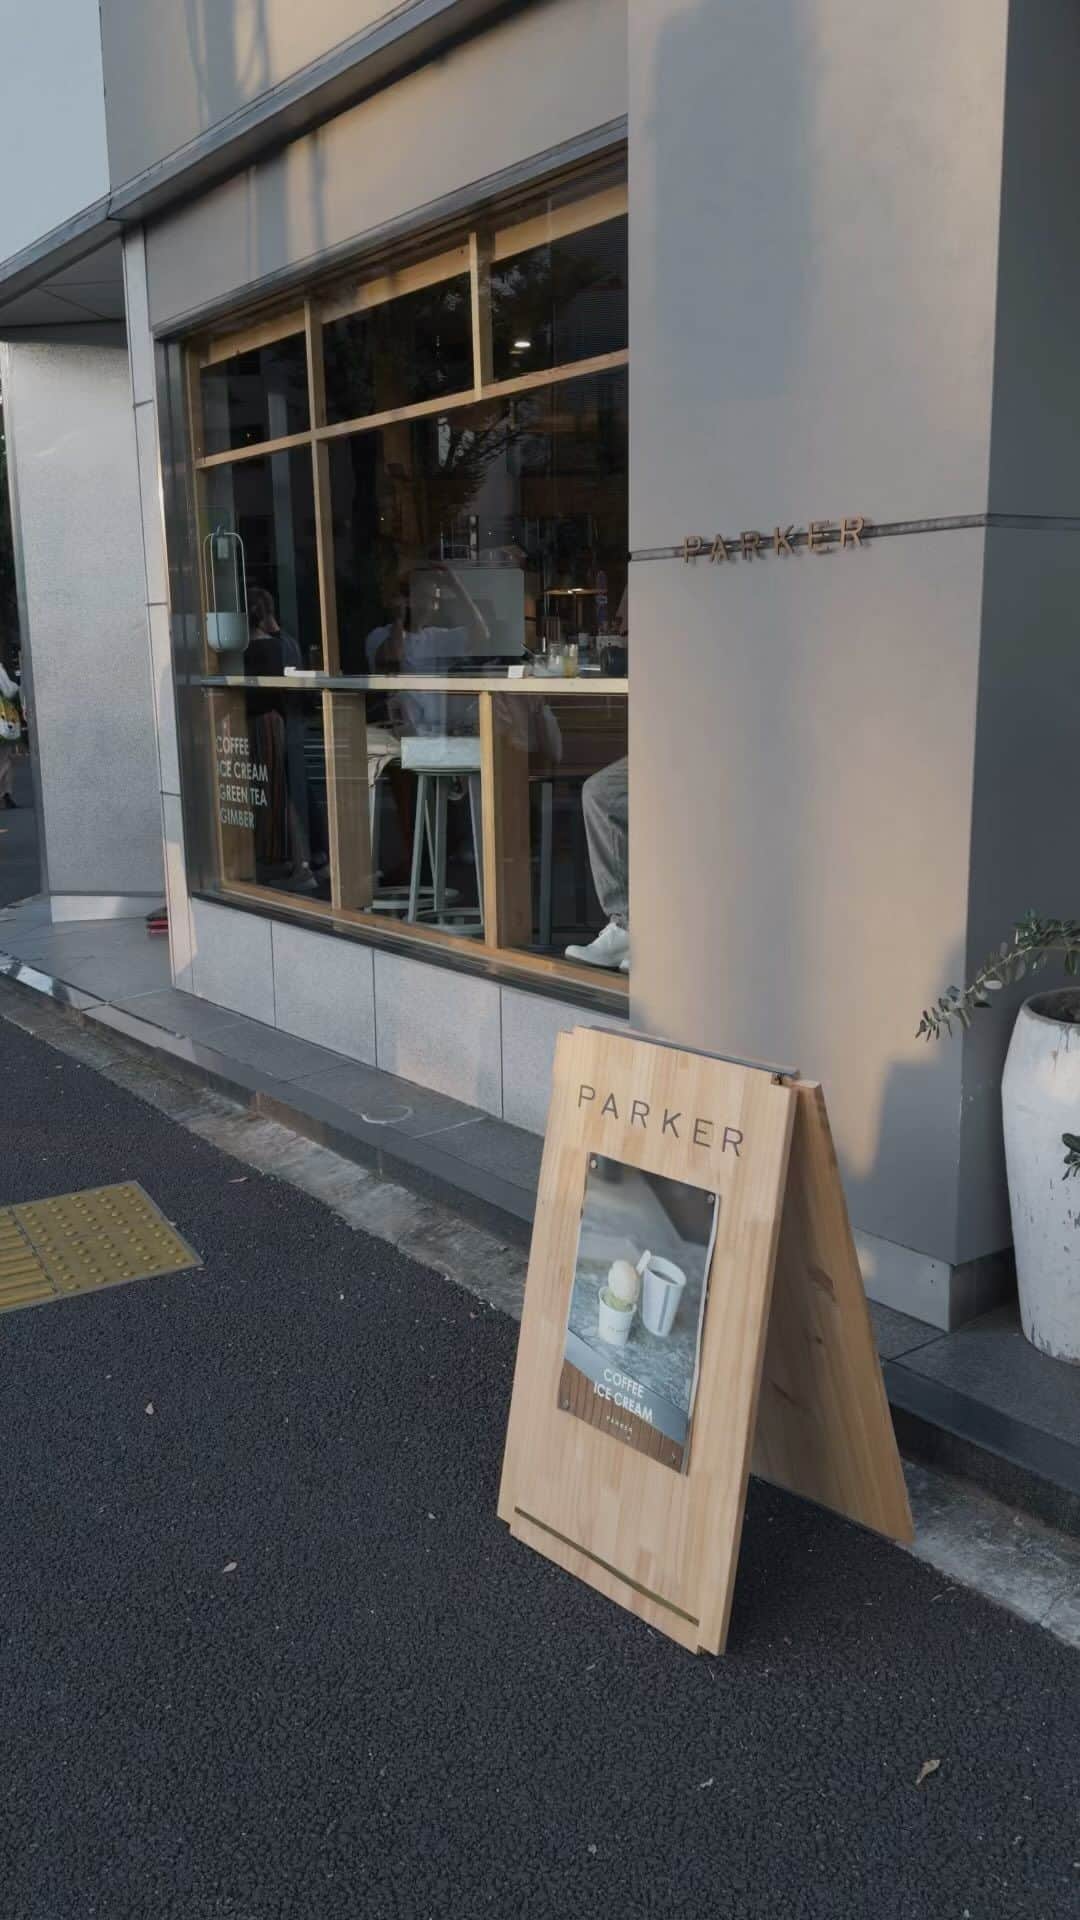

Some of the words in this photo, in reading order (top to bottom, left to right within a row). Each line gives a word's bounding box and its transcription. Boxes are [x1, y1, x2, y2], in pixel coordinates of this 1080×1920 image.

[682, 513, 866, 564] PARKER
[216, 736, 249, 756] COFFEE
[217, 760, 232, 777] ICE
[233, 762, 268, 781] CREAM
[219, 784, 248, 803] GREEN
[250, 787, 268, 806] TEA
[577, 1084, 744, 1157] PARKER
[603, 1368, 644, 1399] COFFEE
[593, 1382, 612, 1401] ICE
[614, 1392, 653, 1424] CREAM
